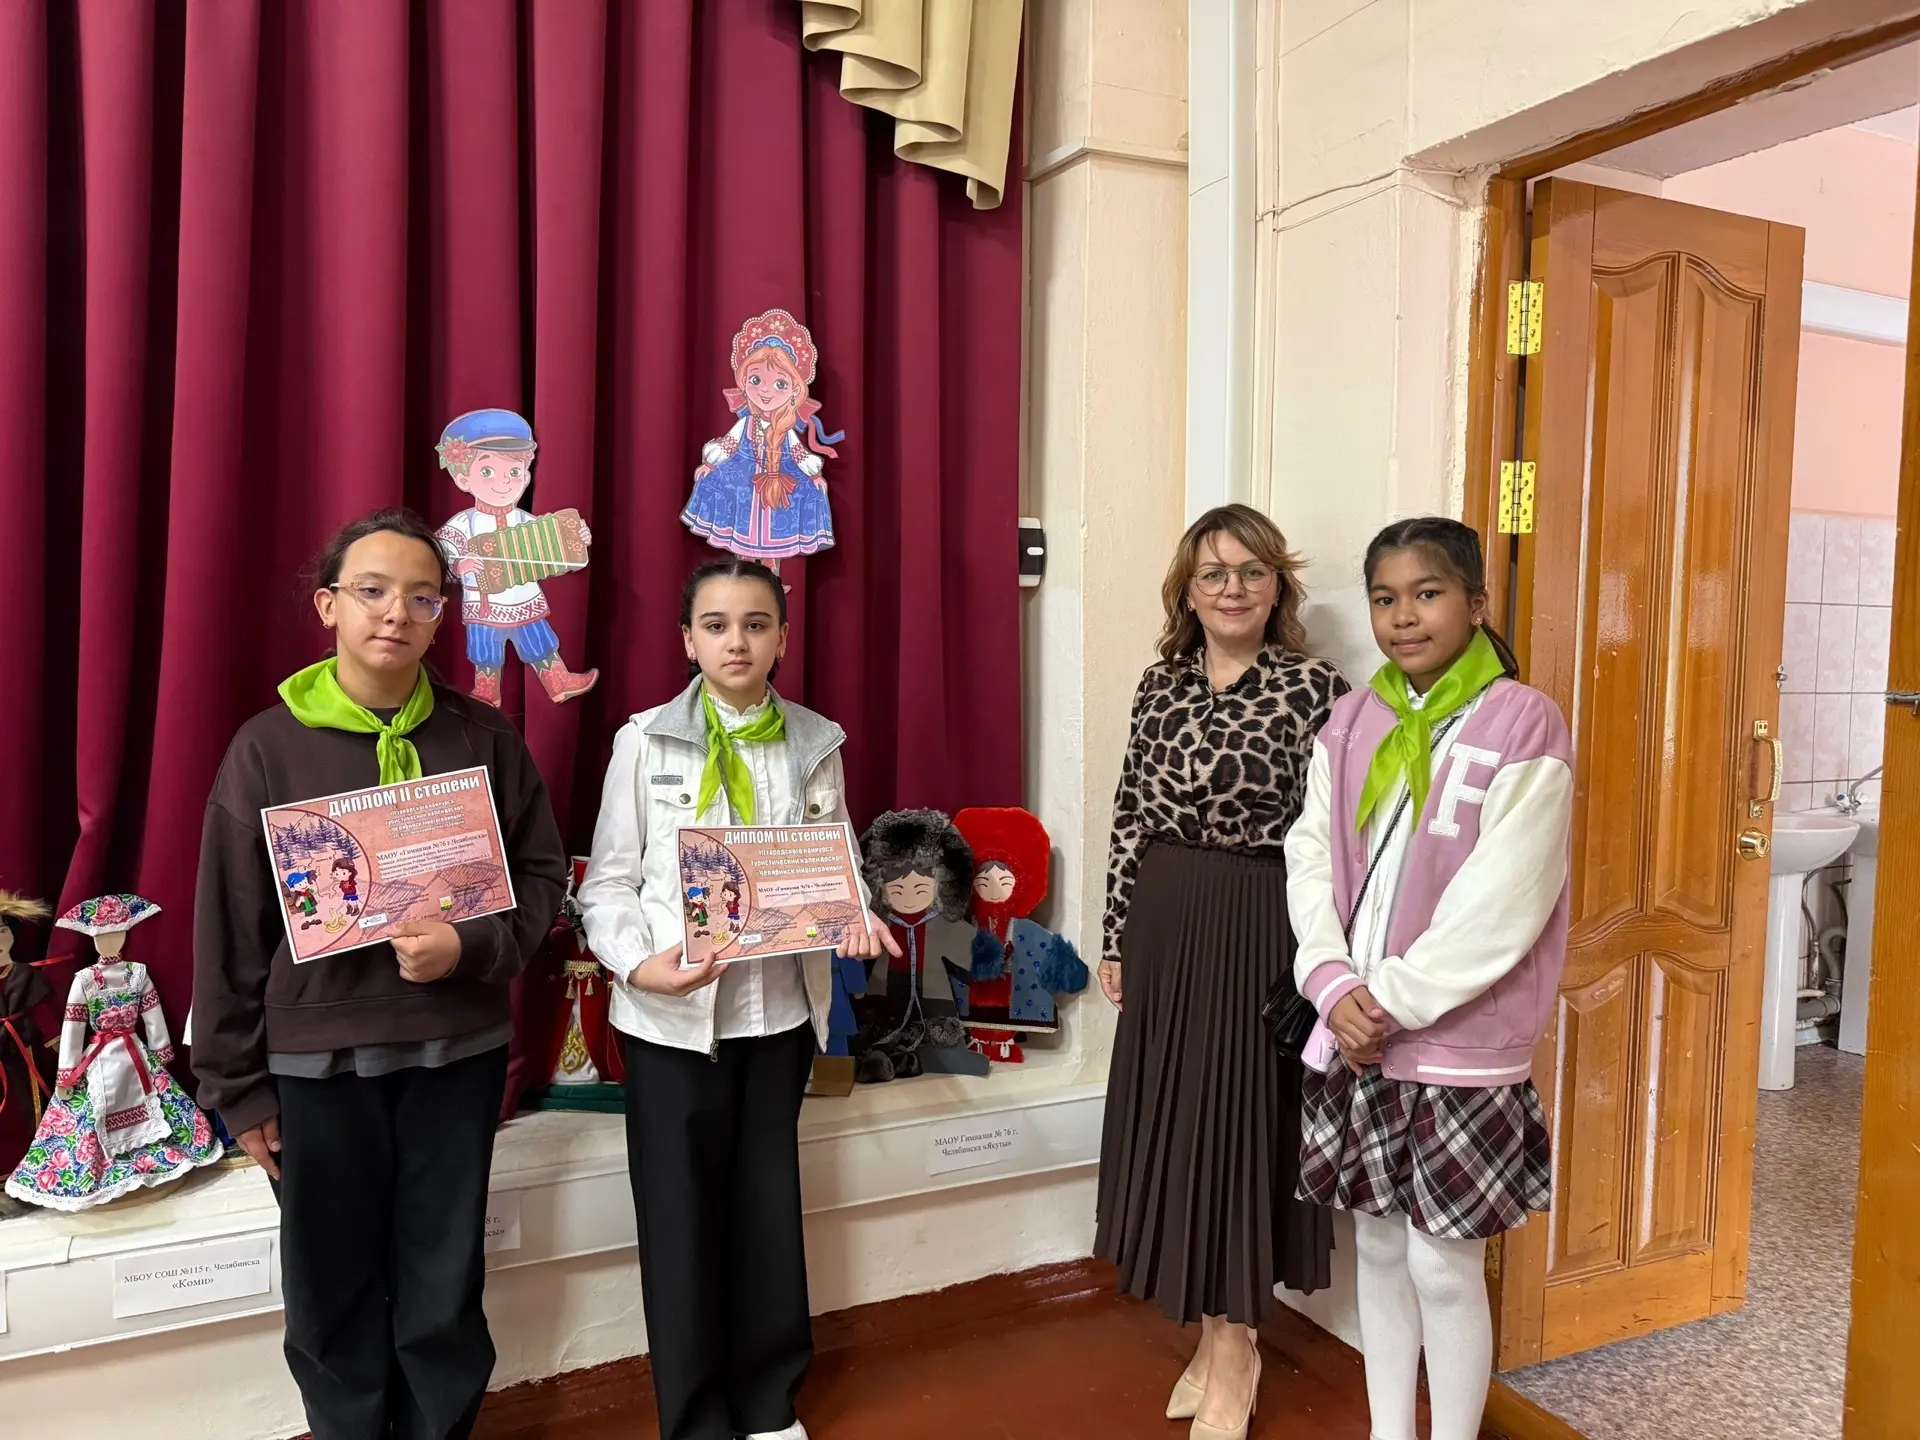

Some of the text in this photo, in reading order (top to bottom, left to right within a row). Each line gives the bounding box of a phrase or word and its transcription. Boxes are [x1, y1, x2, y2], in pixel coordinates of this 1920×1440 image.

[328, 775, 480, 818] ДИПЛОМ II степени
[1428, 743, 1501, 838] F
[724, 830, 841, 846] ДИПЛОМ III степени
[376, 851, 398, 861] МАОУ
[803, 846, 833, 855] конкурса
[934, 1136, 958, 1146] МАОУ
[960, 1132, 993, 1143] Гимназия
[993, 1130, 1003, 1138] №
[1003, 1128, 1012, 1137] 76
[942, 1140, 1011, 1156] Челябинска «Якуты»
[124, 1272, 153, 1284] МБОУ
[154, 1269, 178, 1279] СОШ
[179, 1265, 204, 1276] №115
[213, 1259, 261, 1272] Челябинска
[171, 1276, 215, 1291] «Коми»
